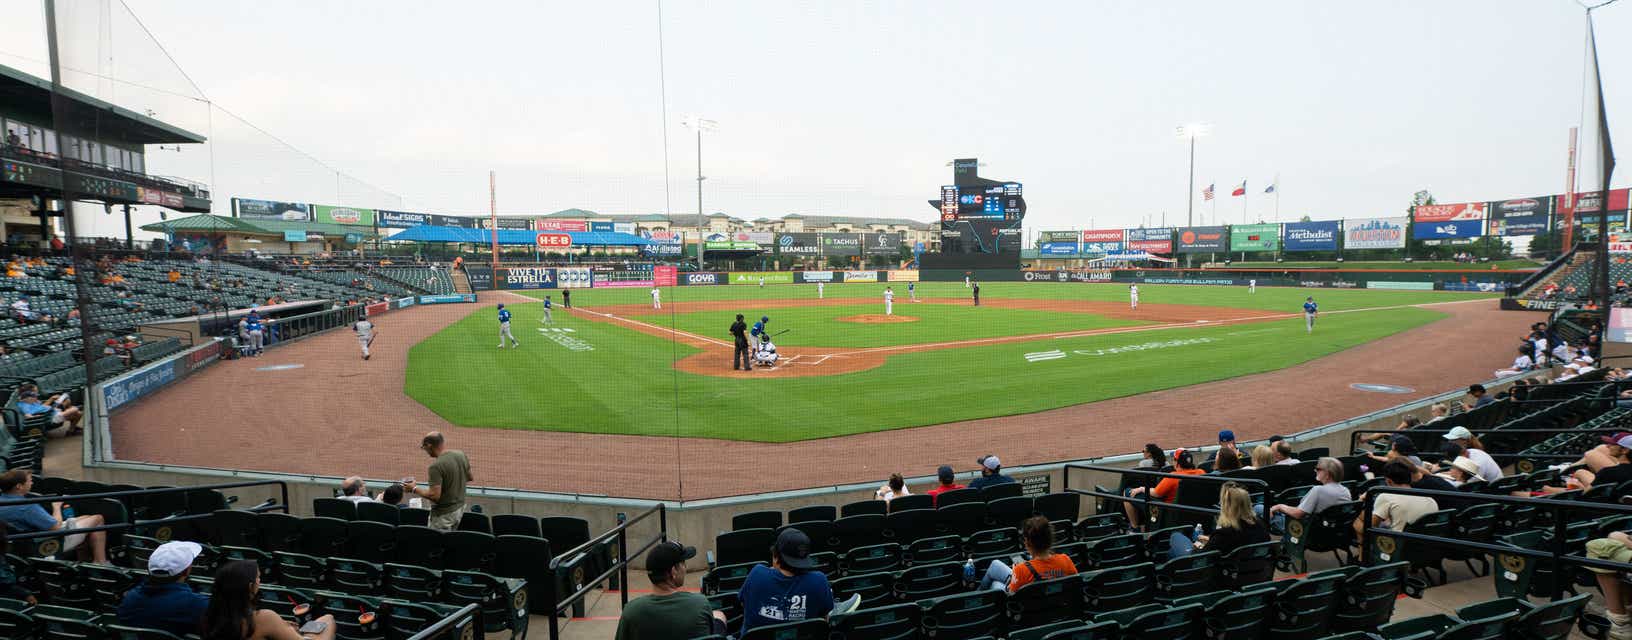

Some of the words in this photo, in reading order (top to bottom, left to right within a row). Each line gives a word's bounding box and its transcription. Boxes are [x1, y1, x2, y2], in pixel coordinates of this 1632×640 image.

[1289, 230, 1332, 240] Methodist
[1350, 230, 1401, 241] HOUSTON
[510, 268, 532, 276] VIVE
[535, 267, 545, 275] TU
[508, 275, 552, 284] ESTRELLA
[689, 274, 715, 283] GOYA
[1527, 300, 1556, 310] FINE
[791, 595, 807, 610] 21
